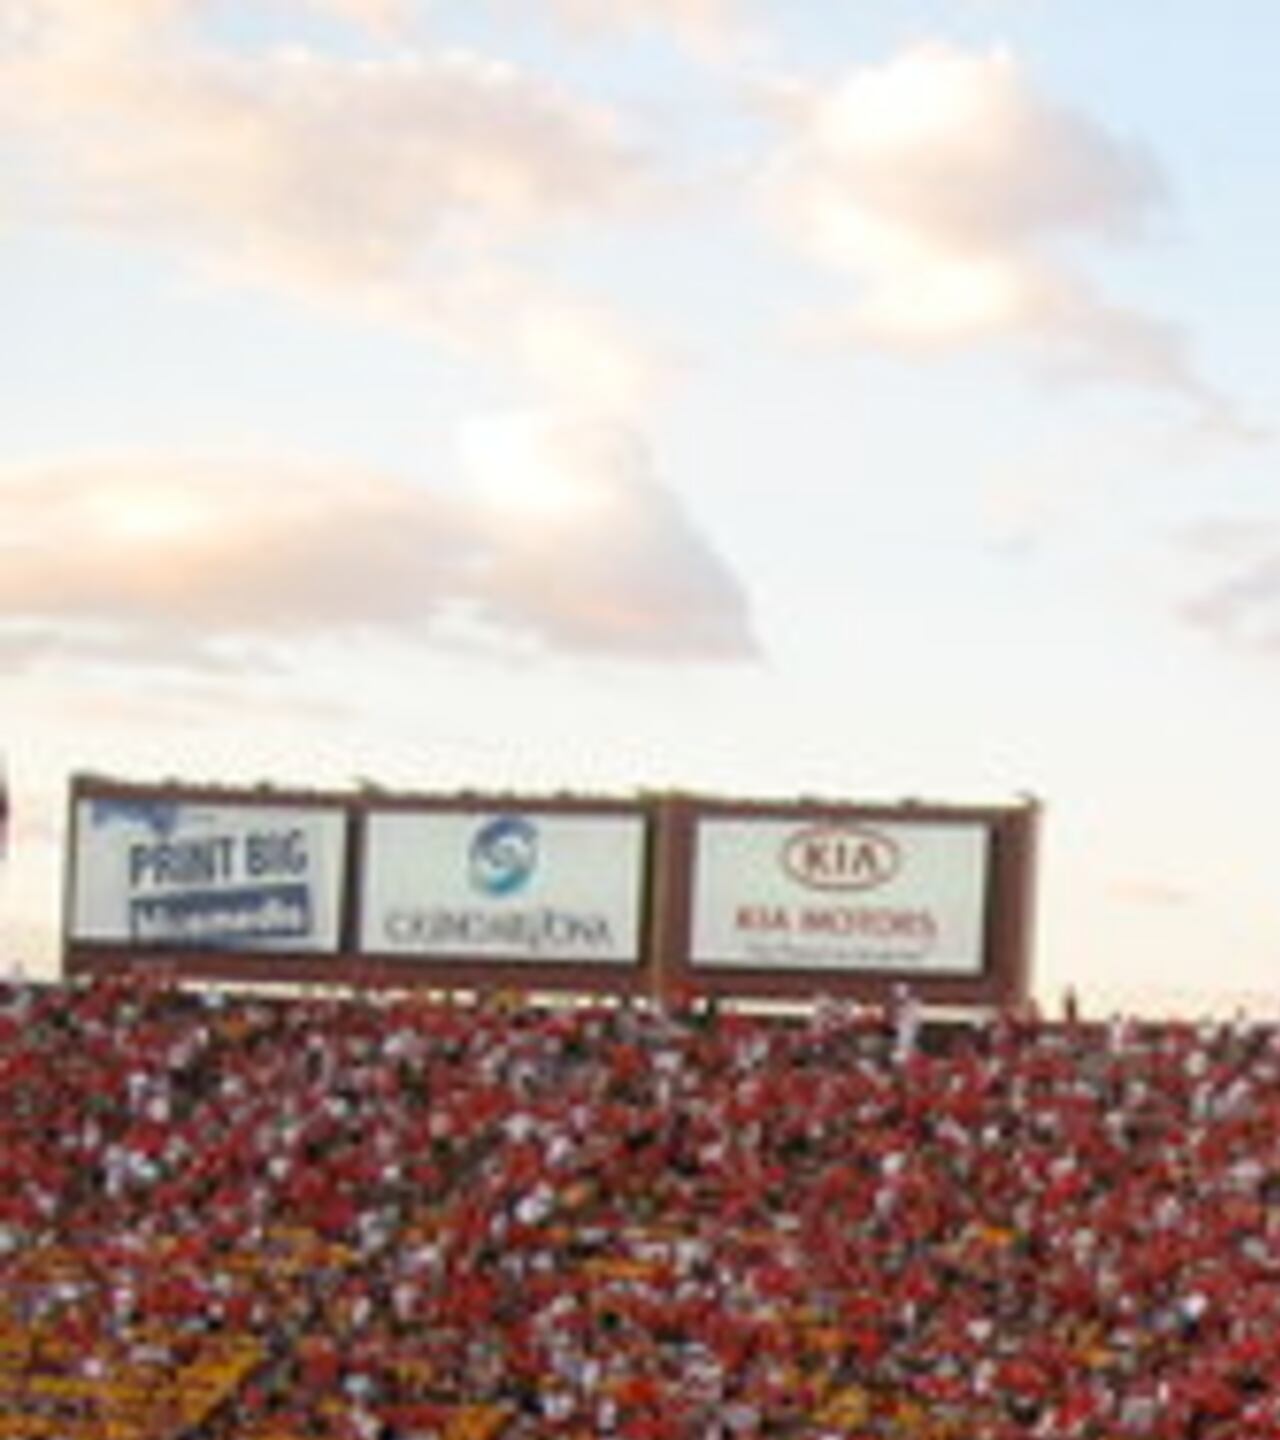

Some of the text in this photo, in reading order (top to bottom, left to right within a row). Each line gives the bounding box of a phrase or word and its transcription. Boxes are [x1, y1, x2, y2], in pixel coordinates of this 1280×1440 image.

[129, 829, 307, 887] PRINT BIG
[803, 840, 879, 877] KIA
[735, 905, 938, 939] KIA MOTORS
